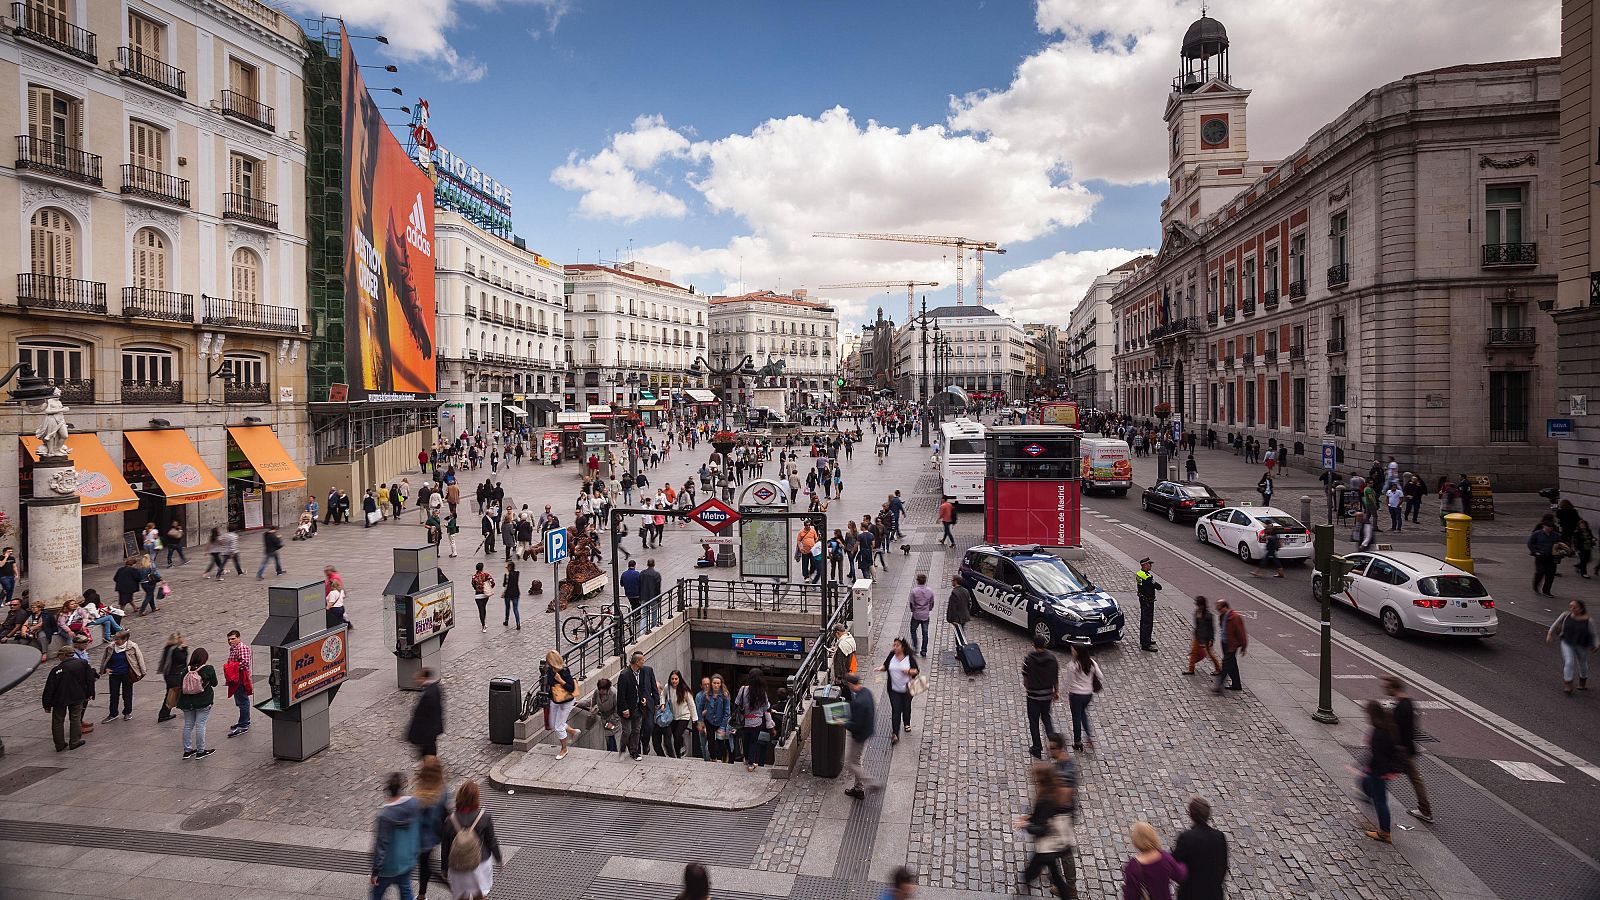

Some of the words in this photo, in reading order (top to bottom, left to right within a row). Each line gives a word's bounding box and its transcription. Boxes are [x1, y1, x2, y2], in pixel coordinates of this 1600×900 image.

[437, 144, 466, 179] TIO
[471, 165, 513, 208] PEPE
[354, 224, 382, 275] DESTROY
[406, 225, 431, 257] adidas
[358, 261, 379, 300] ORDER
[89, 504, 119, 513] PICCADILLY
[1057, 485, 1065, 511] Madrid
[702, 512, 725, 520] Metro
[1057, 512, 1065, 522] de
[552, 532, 564, 558] P
[1057, 523, 1065, 545] Metro
[974, 580, 1029, 610] POLICÍA
[988, 602, 1013, 617] MADRID
[293, 670, 318, 685] CAMBIO
[322, 658, 345, 672] CHANGE
[294, 652, 315, 671] Ria
[297, 681, 308, 690] NO
